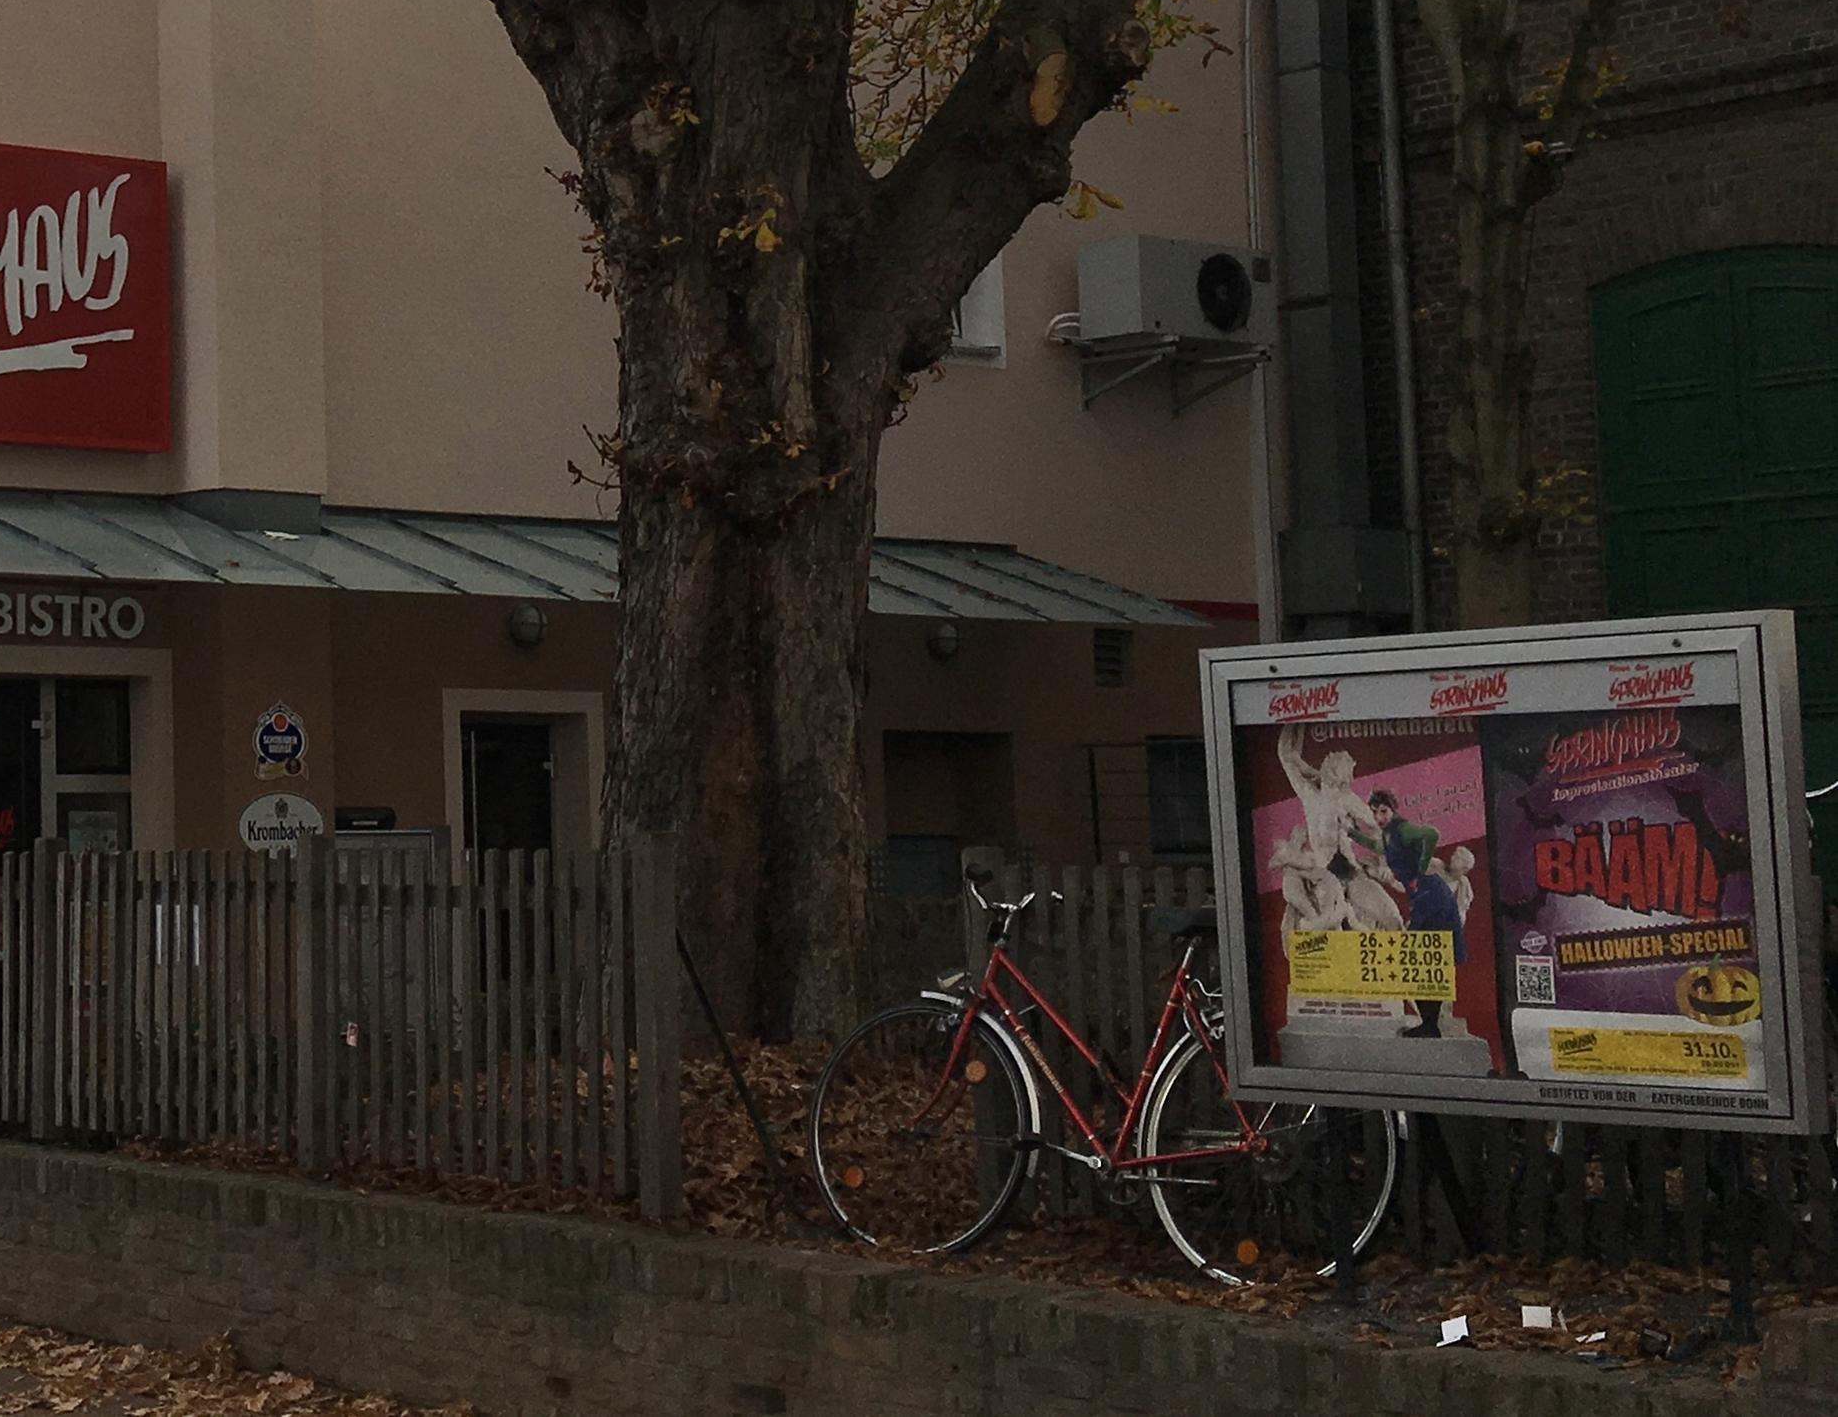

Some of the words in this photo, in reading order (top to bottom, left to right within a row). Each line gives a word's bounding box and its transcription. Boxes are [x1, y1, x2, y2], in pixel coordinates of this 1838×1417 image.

[247, 820, 318, 841] Krombacher
[1534, 816, 1721, 923] BÄÄM!
[1359, 934, 1383, 949] 26.
[1400, 934, 1447, 949] 27.08.
[1561, 928, 1749, 965] HALLOWEEN-SPECIAL
[1360, 951, 1381, 965] 27.
[1399, 951, 1449, 966] 28.09.
[1362, 968, 1384, 982] 21.
[1402, 969, 1449, 983] 22.10.
[1682, 1042, 1738, 1059] 31.10.
[1593, 1090, 1613, 1101] VON
[1616, 1091, 1636, 1103] DER
